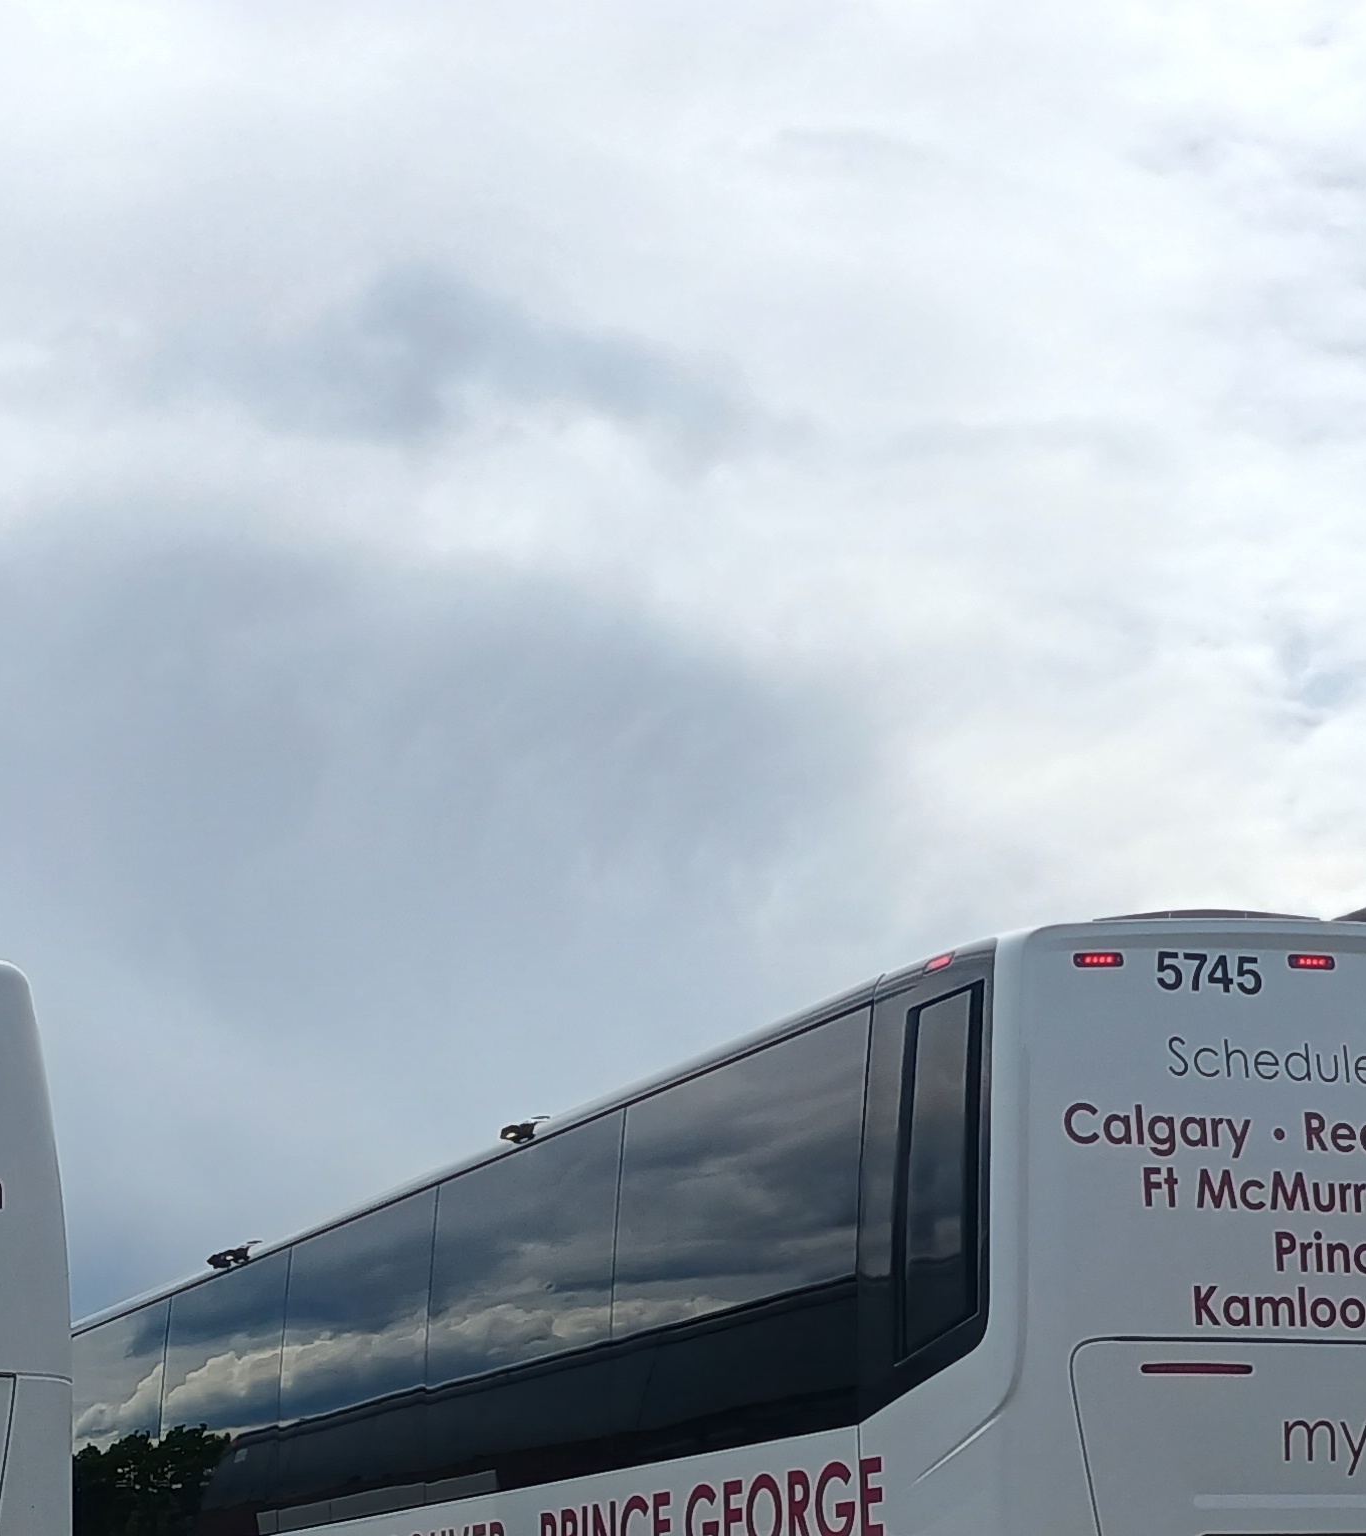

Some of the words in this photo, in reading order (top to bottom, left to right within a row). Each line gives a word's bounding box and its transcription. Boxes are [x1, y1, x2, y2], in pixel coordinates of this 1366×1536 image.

[1156, 950, 1262, 996] 5745
[1063, 1102, 1251, 1159] Calgary
[1143, 1166, 1179, 1208] Ft
